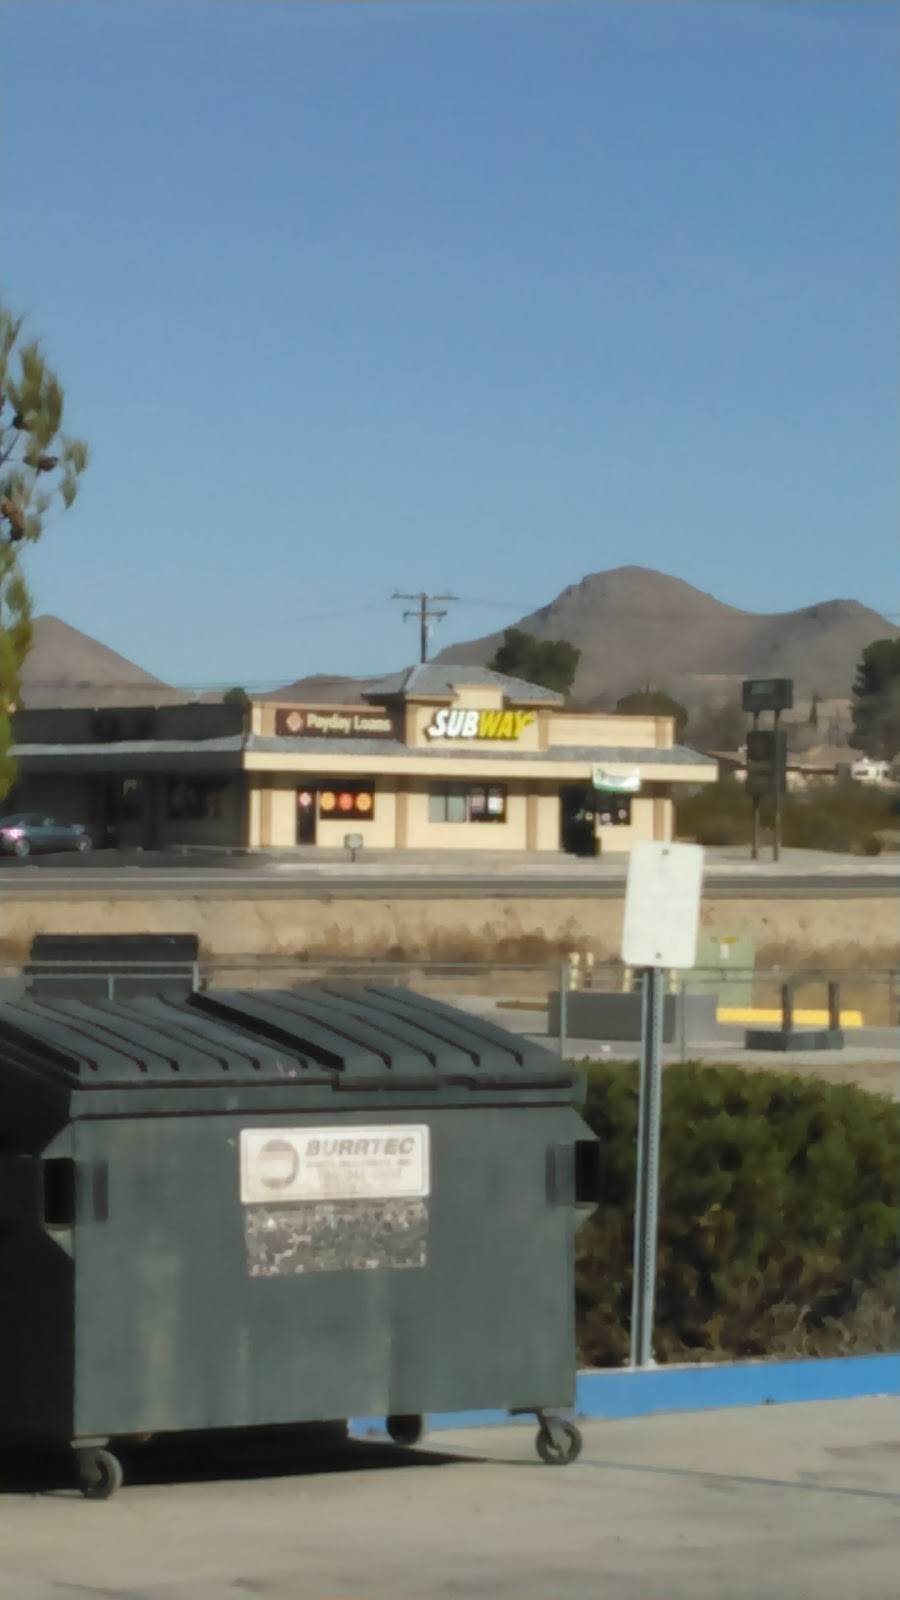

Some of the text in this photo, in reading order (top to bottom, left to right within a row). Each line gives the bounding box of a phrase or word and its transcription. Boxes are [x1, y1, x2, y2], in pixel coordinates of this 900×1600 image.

[306, 713, 391, 734] Payday Loans
[427, 709, 534, 738] SUBWAY
[305, 1136, 415, 1157] BURRTEC
